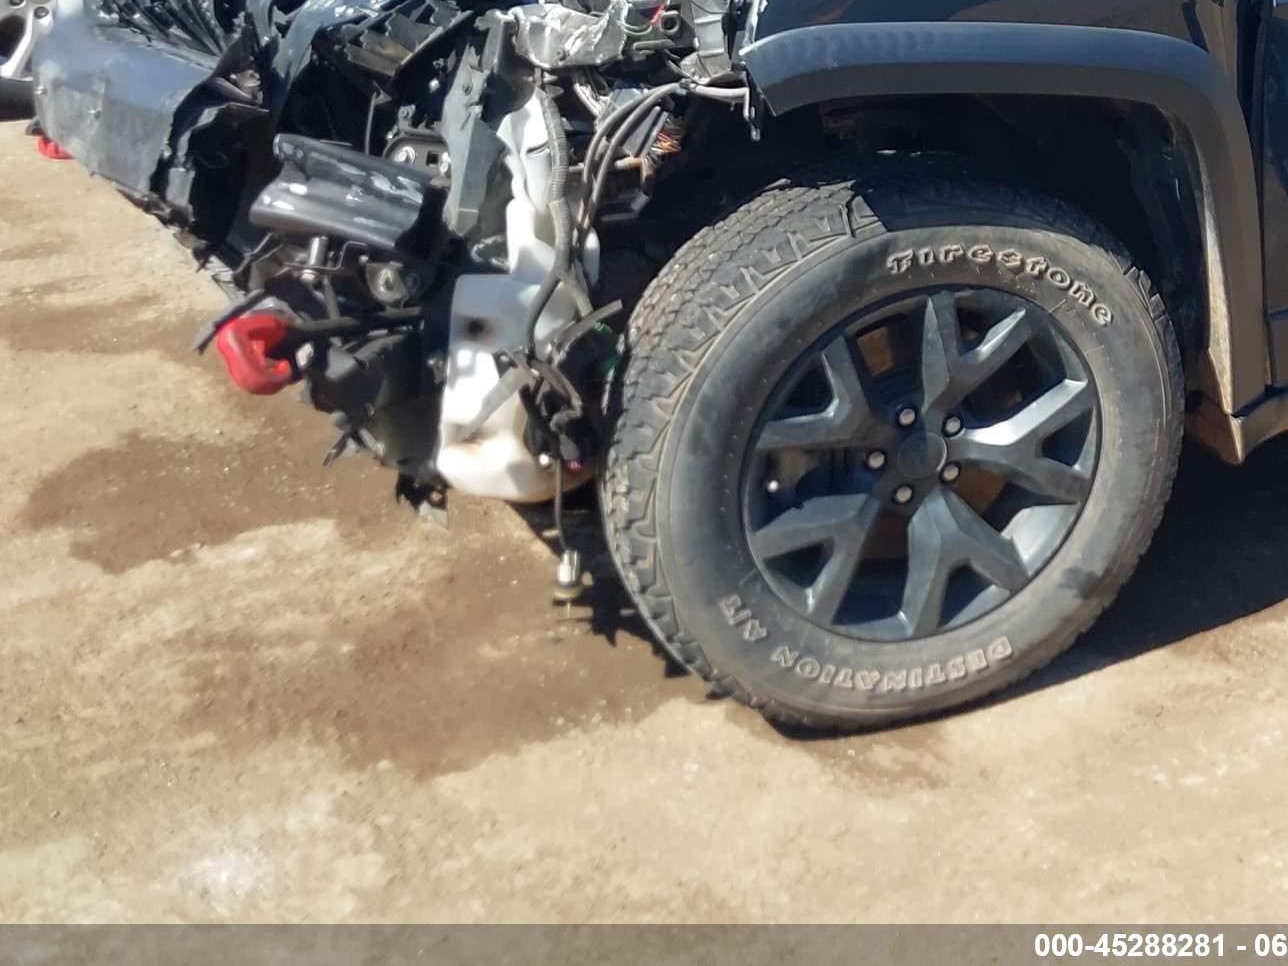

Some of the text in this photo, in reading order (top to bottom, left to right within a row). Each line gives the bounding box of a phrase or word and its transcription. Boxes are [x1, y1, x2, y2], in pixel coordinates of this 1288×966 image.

[886, 243, 1113, 326] Firestone
[718, 593, 1013, 691] DESTINATION A/T
